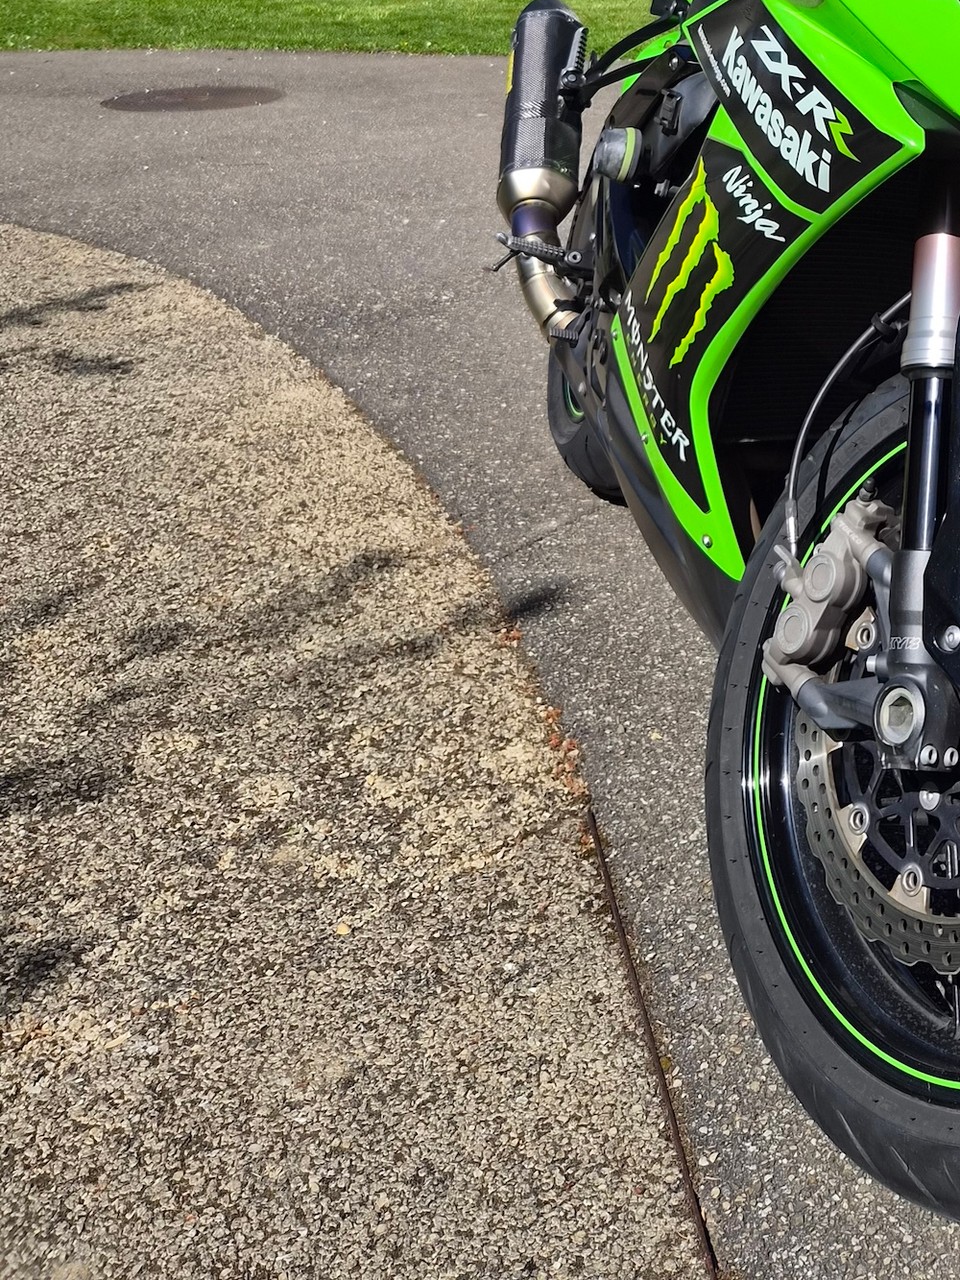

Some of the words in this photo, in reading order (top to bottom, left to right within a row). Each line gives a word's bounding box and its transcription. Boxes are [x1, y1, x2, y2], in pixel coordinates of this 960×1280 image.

[721, 25, 831, 193] Kawasaki
[721, 165, 786, 243] Ninja
[624, 289, 690, 462] MONSTER
